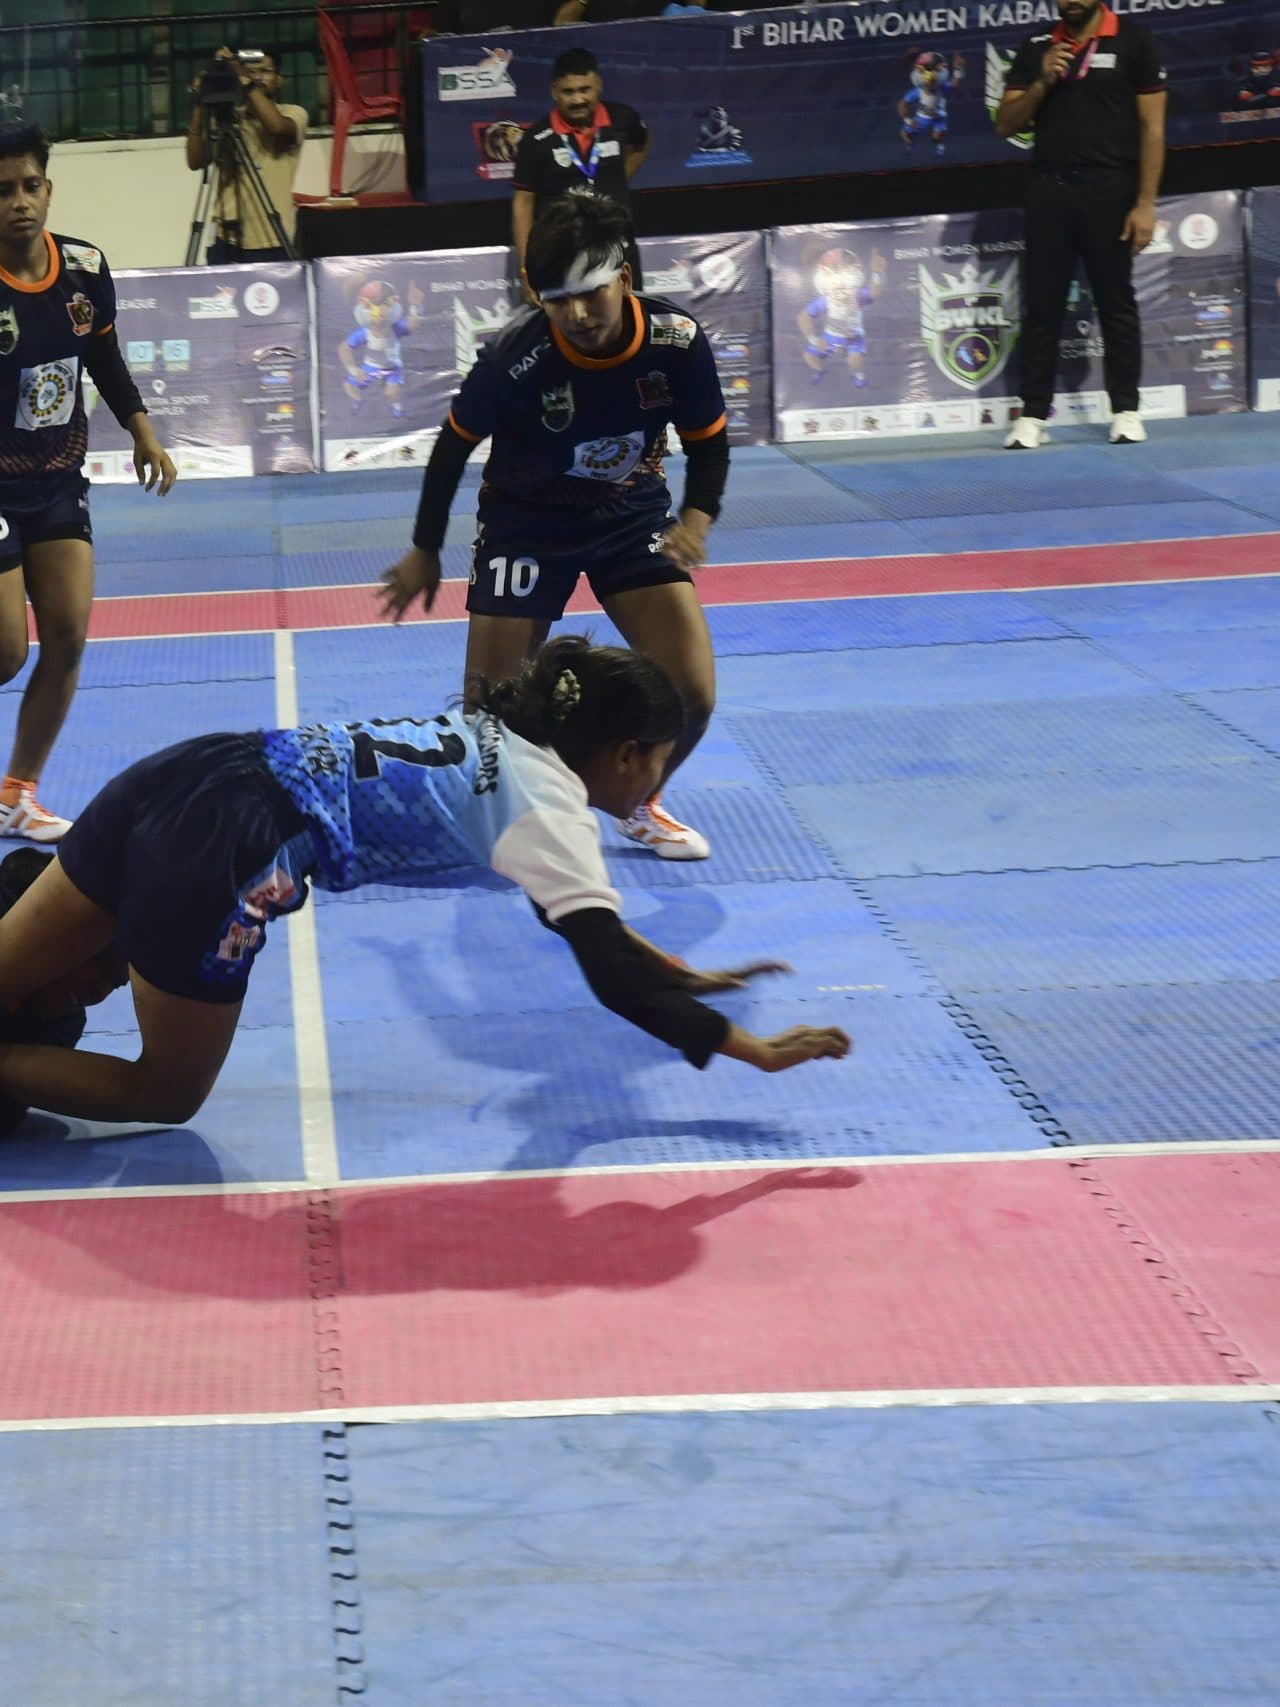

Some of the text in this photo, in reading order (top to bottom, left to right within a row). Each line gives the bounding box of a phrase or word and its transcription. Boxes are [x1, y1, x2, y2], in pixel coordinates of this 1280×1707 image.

[731, 23, 754, 49] 1st
[763, 18, 845, 47] BIHAR
[854, 6, 967, 38] WOMEN
[488, 556, 540, 598] 10
